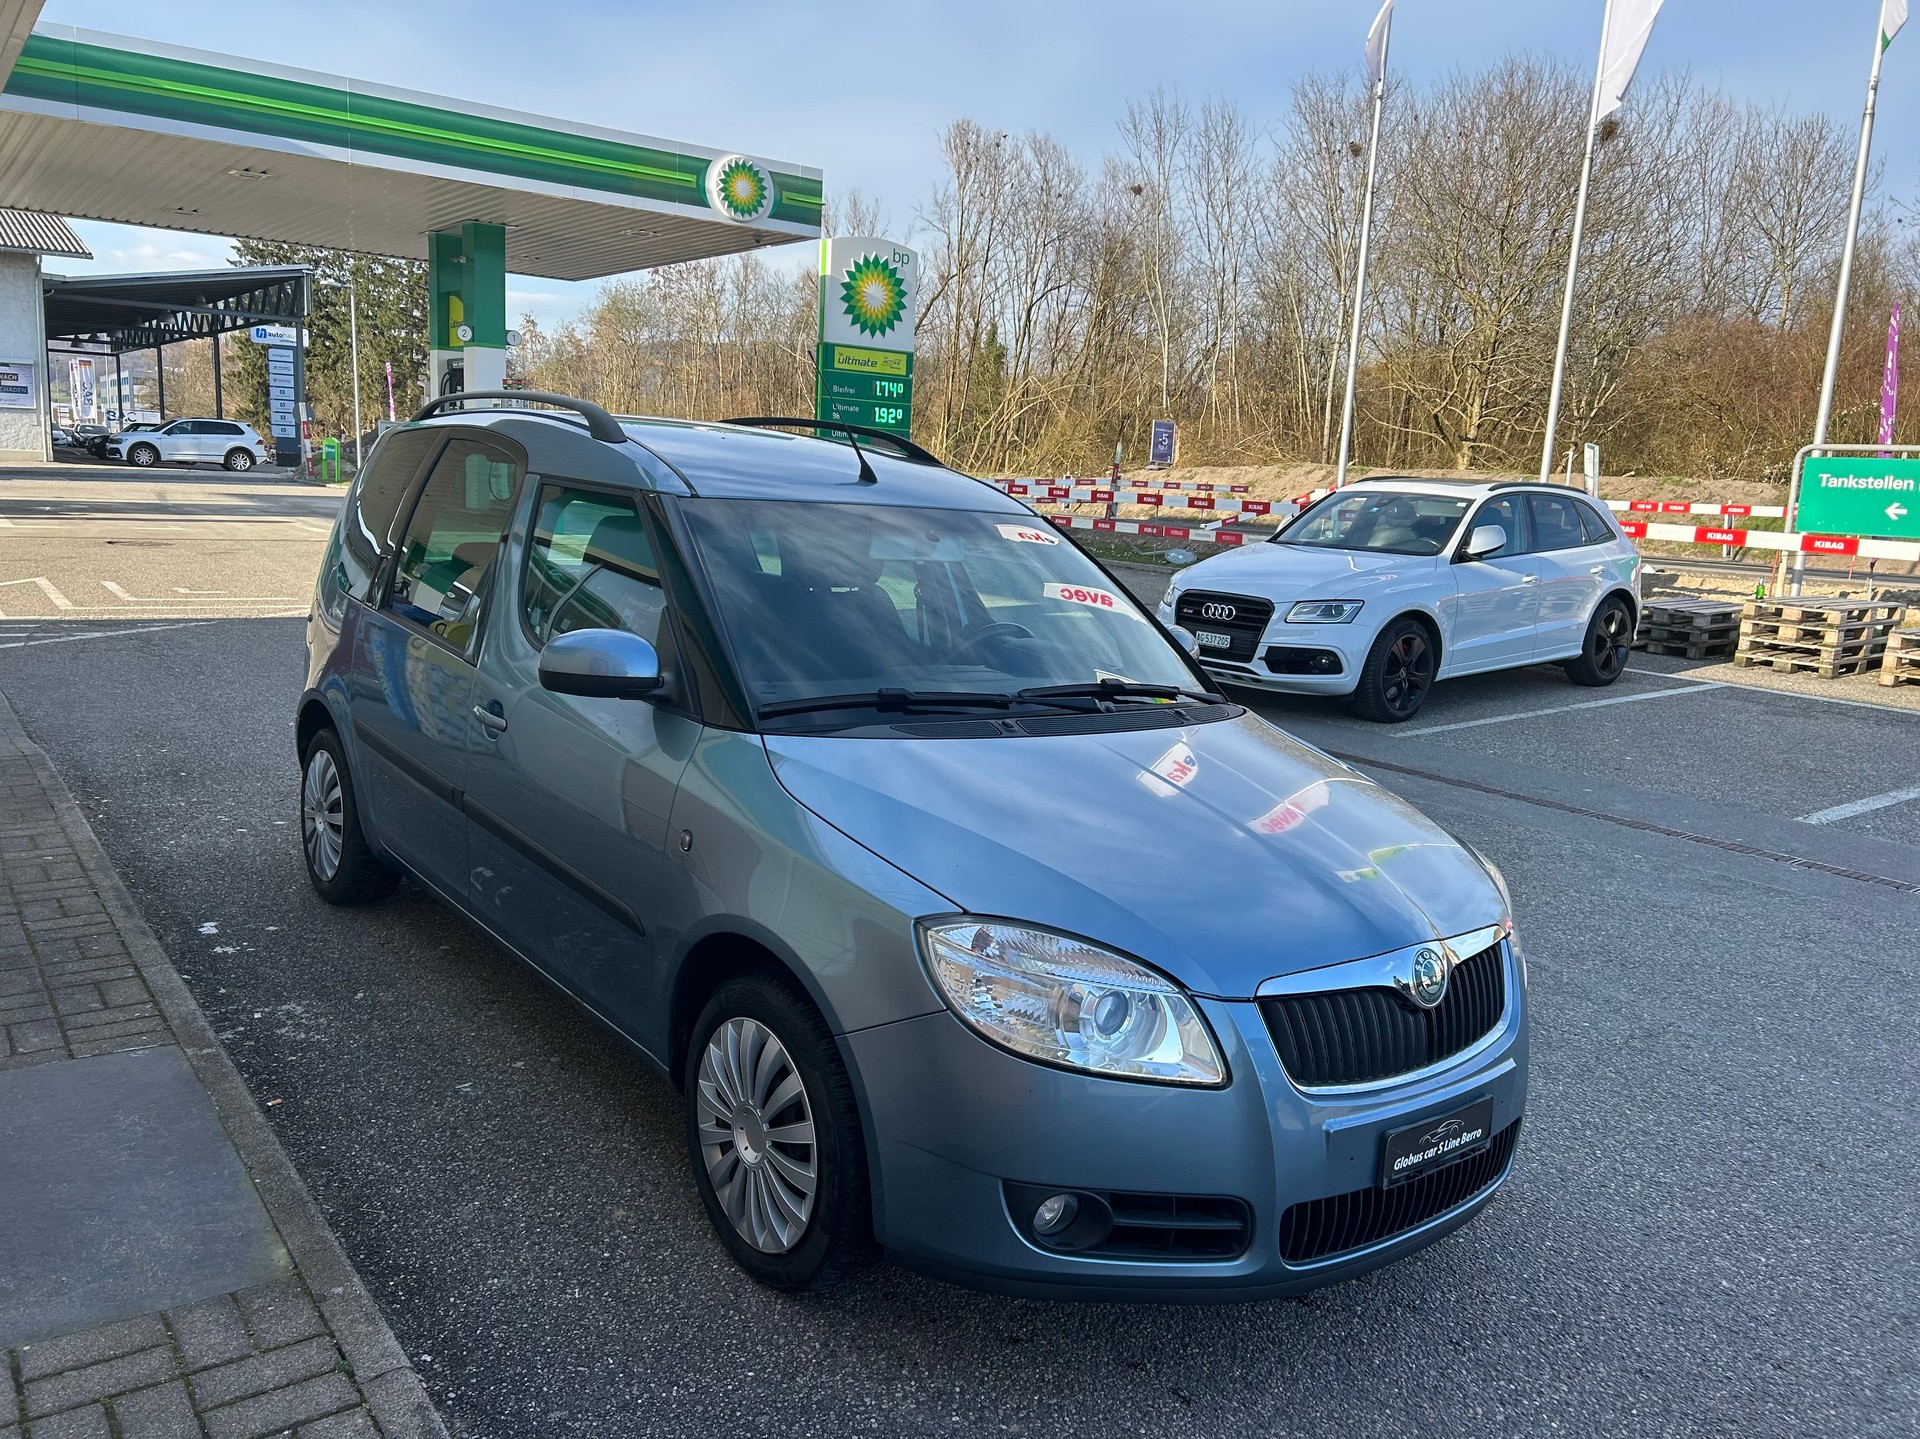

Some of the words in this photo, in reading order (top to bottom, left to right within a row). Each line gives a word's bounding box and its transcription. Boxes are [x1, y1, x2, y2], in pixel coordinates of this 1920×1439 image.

[893, 248, 910, 268] bp
[462, 329, 467, 338] 2
[837, 355, 878, 368] ultimate
[832, 384, 856, 394] Bleifrei
[1818, 473, 1915, 492] Tankstellen
[1706, 532, 1734, 541] KIBAG
[1814, 540, 1845, 550] KIBAG
[1205, 634, 1218, 644] 537
[1217, 636, 1230, 646] 205
[1394, 1151, 1424, 1171] Globus
[1424, 1147, 1438, 1160] car
[1437, 1142, 1444, 1154] S
[1444, 1138, 1460, 1152] Line
[1461, 1128, 1482, 1145] Berro
